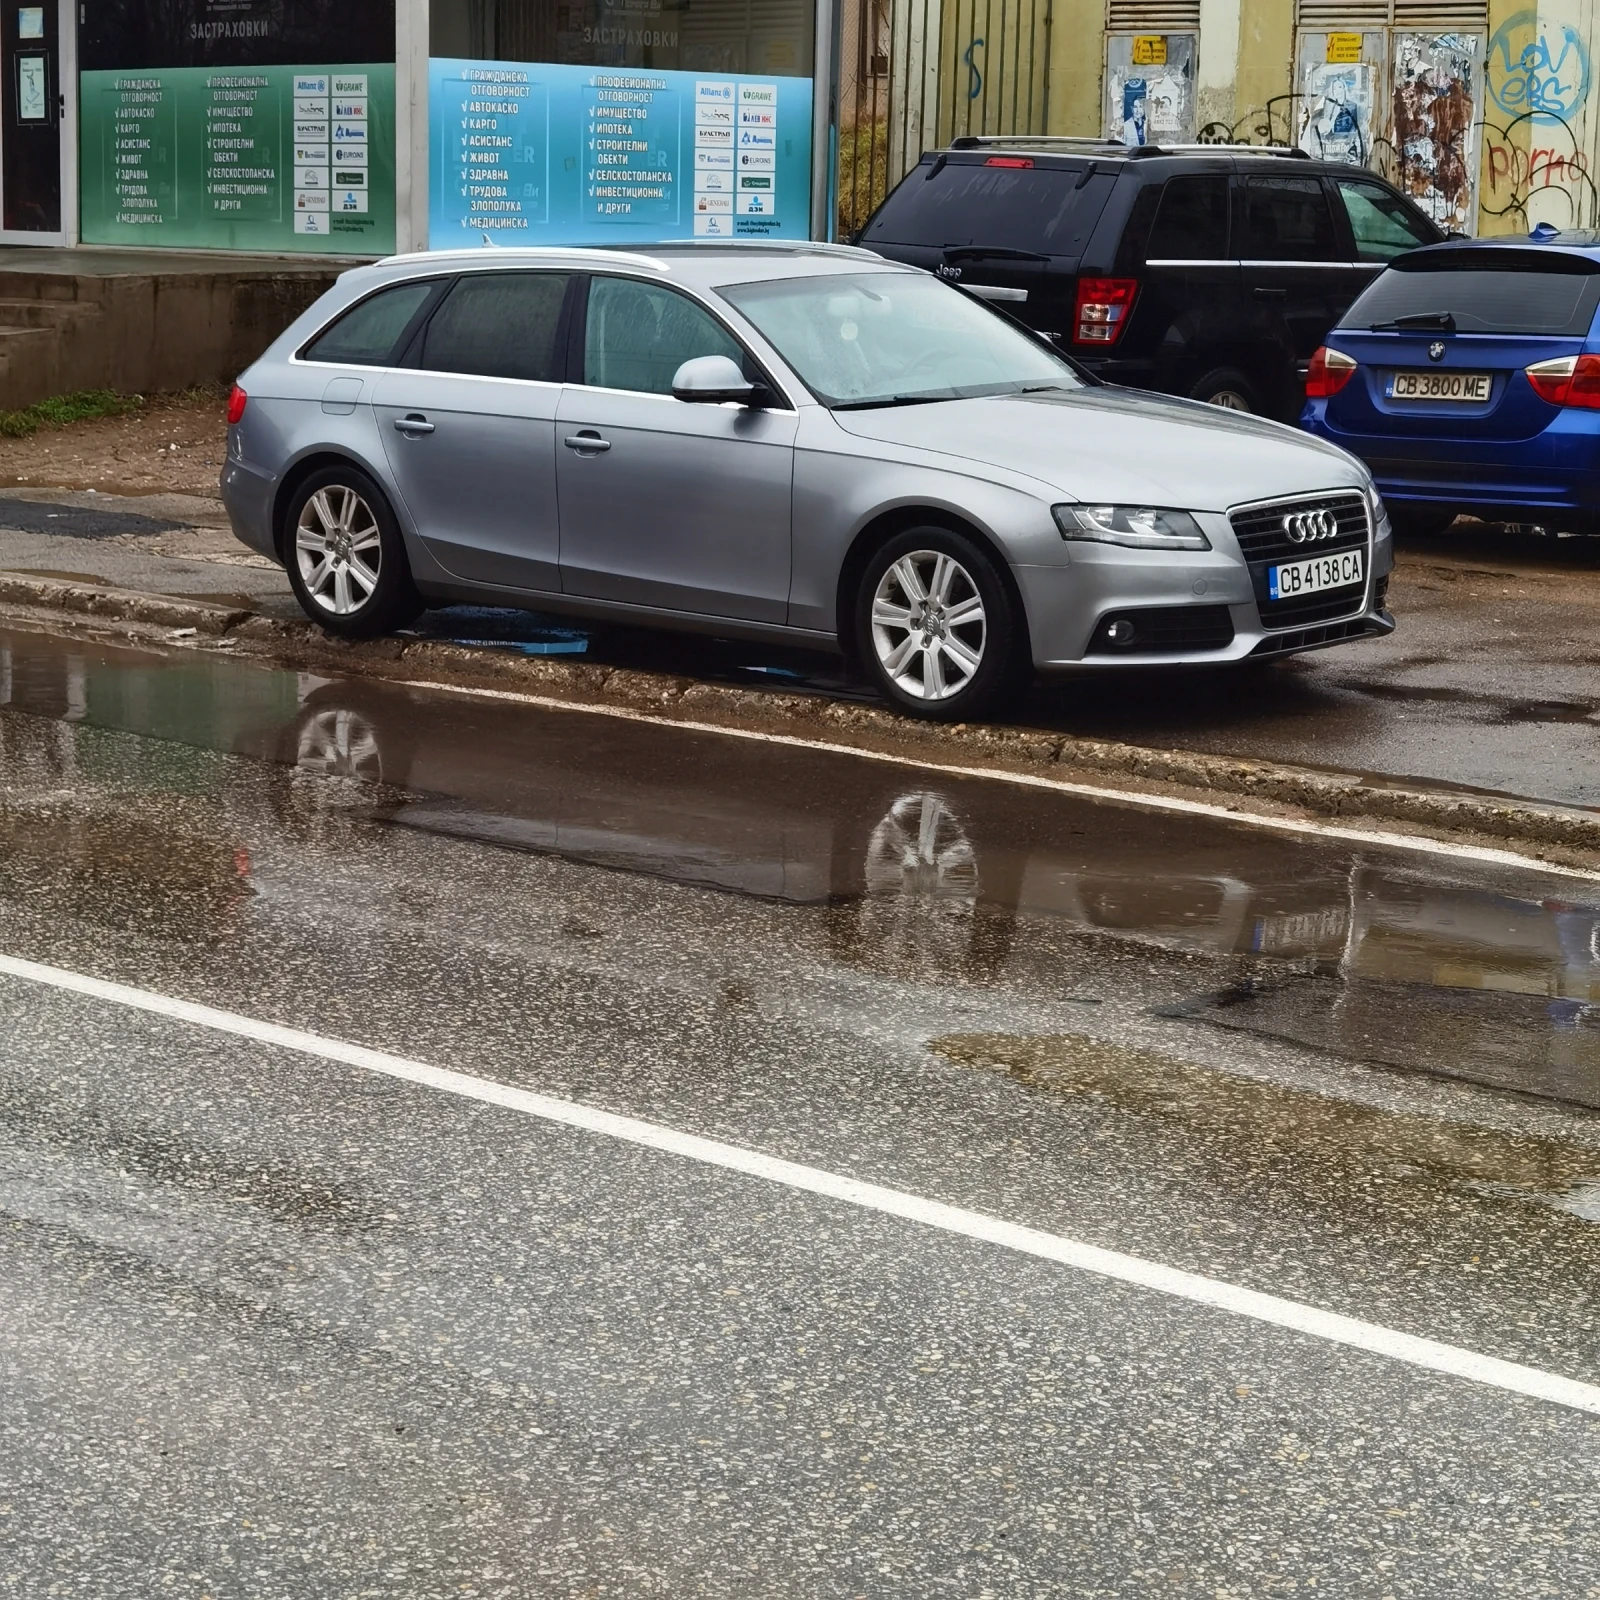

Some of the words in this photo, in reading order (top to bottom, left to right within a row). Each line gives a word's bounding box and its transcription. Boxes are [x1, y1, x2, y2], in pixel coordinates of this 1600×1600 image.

[190, 20, 268, 39] ЗАСТРАХОВКИ
[583, 27, 679, 47] ЗАСТРАХОВКИ
[212, 76, 269, 88] ПРОФЕСИОНАЛНА
[470, 69, 528, 84] ГРАЖДАНСКА
[597, 76, 667, 89] ПРОФЕСИОНАЛНА
[120, 79, 161, 90] ГРАЖДАНСКА
[471, 84, 530, 97] ОТГОВОРНОСТ
[121, 92, 162, 102] ОТГОВОРНОСТ
[213, 90, 258, 101] ОТГОВОРНОСТ
[598, 90, 653, 103] ОТГОВОРНОСТ
[700, 87, 722, 97] Allianz
[751, 91, 772, 101] GRAWE
[120, 107, 155, 118] АВТОКАСКО
[212, 106, 254, 118] ИМУЩЕСТВО
[470, 101, 519, 114] АВТОКАСКО
[597, 107, 647, 119] ИМУЩЕСТВО
[120, 123, 140, 133] КАРГО
[212, 122, 242, 133] ИПОТЕКА
[469, 118, 497, 130] КАРГО
[597, 123, 633, 135] ИПОТЕКА
[120, 138, 151, 149] АСИСТАНС
[212, 138, 255, 149] СТРОИТЕЛНИ
[469, 135, 513, 147] АСИСТАНС
[596, 139, 648, 151] СТРОИТЕЛНИ
[121, 154, 142, 164] ЖИВОТ
[213, 152, 239, 163] ОБЕКТИ
[469, 152, 500, 163] ЖИВОТ
[597, 153, 628, 165] ОБЕКТИ
[749, 157, 771, 165] EUROINS
[121, 169, 149, 180] ЗДРАВНА
[212, 168, 275, 179] СЕЛСКОСТОПАНСКА
[469, 169, 509, 181] ЗДРАВНА
[596, 169, 673, 182] СЕЛСКОСТОПАНСКА
[121, 185, 148, 196] ТРУДОВА
[213, 184, 268, 196] ИНВЕСТИЦИОННА
[469, 185, 507, 198] ТРУДОВА
[596, 186, 663, 198] ИНВЕСТИЦИОННА
[214, 200, 219, 210] И
[220, 200, 242, 211] ДРУГИ
[471, 200, 522, 212] ЗЛОПОЛУКА
[597, 203, 603, 213] И
[605, 203, 631, 214] ДРУГИ
[121, 213, 163, 224] МЕДИЦИНСКА
[469, 217, 529, 229] МЕДИЦИНСКА
[936, 263, 962, 279] Jeep
[1395, 375, 1418, 395] CB
[1419, 376, 1461, 396] 3800
[1463, 377, 1487, 397] ME
[1270, 587, 1278, 595] BG
[1280, 566, 1301, 593] CB
[1305, 559, 1340, 589] 4138
[1342, 554, 1360, 581] CA
